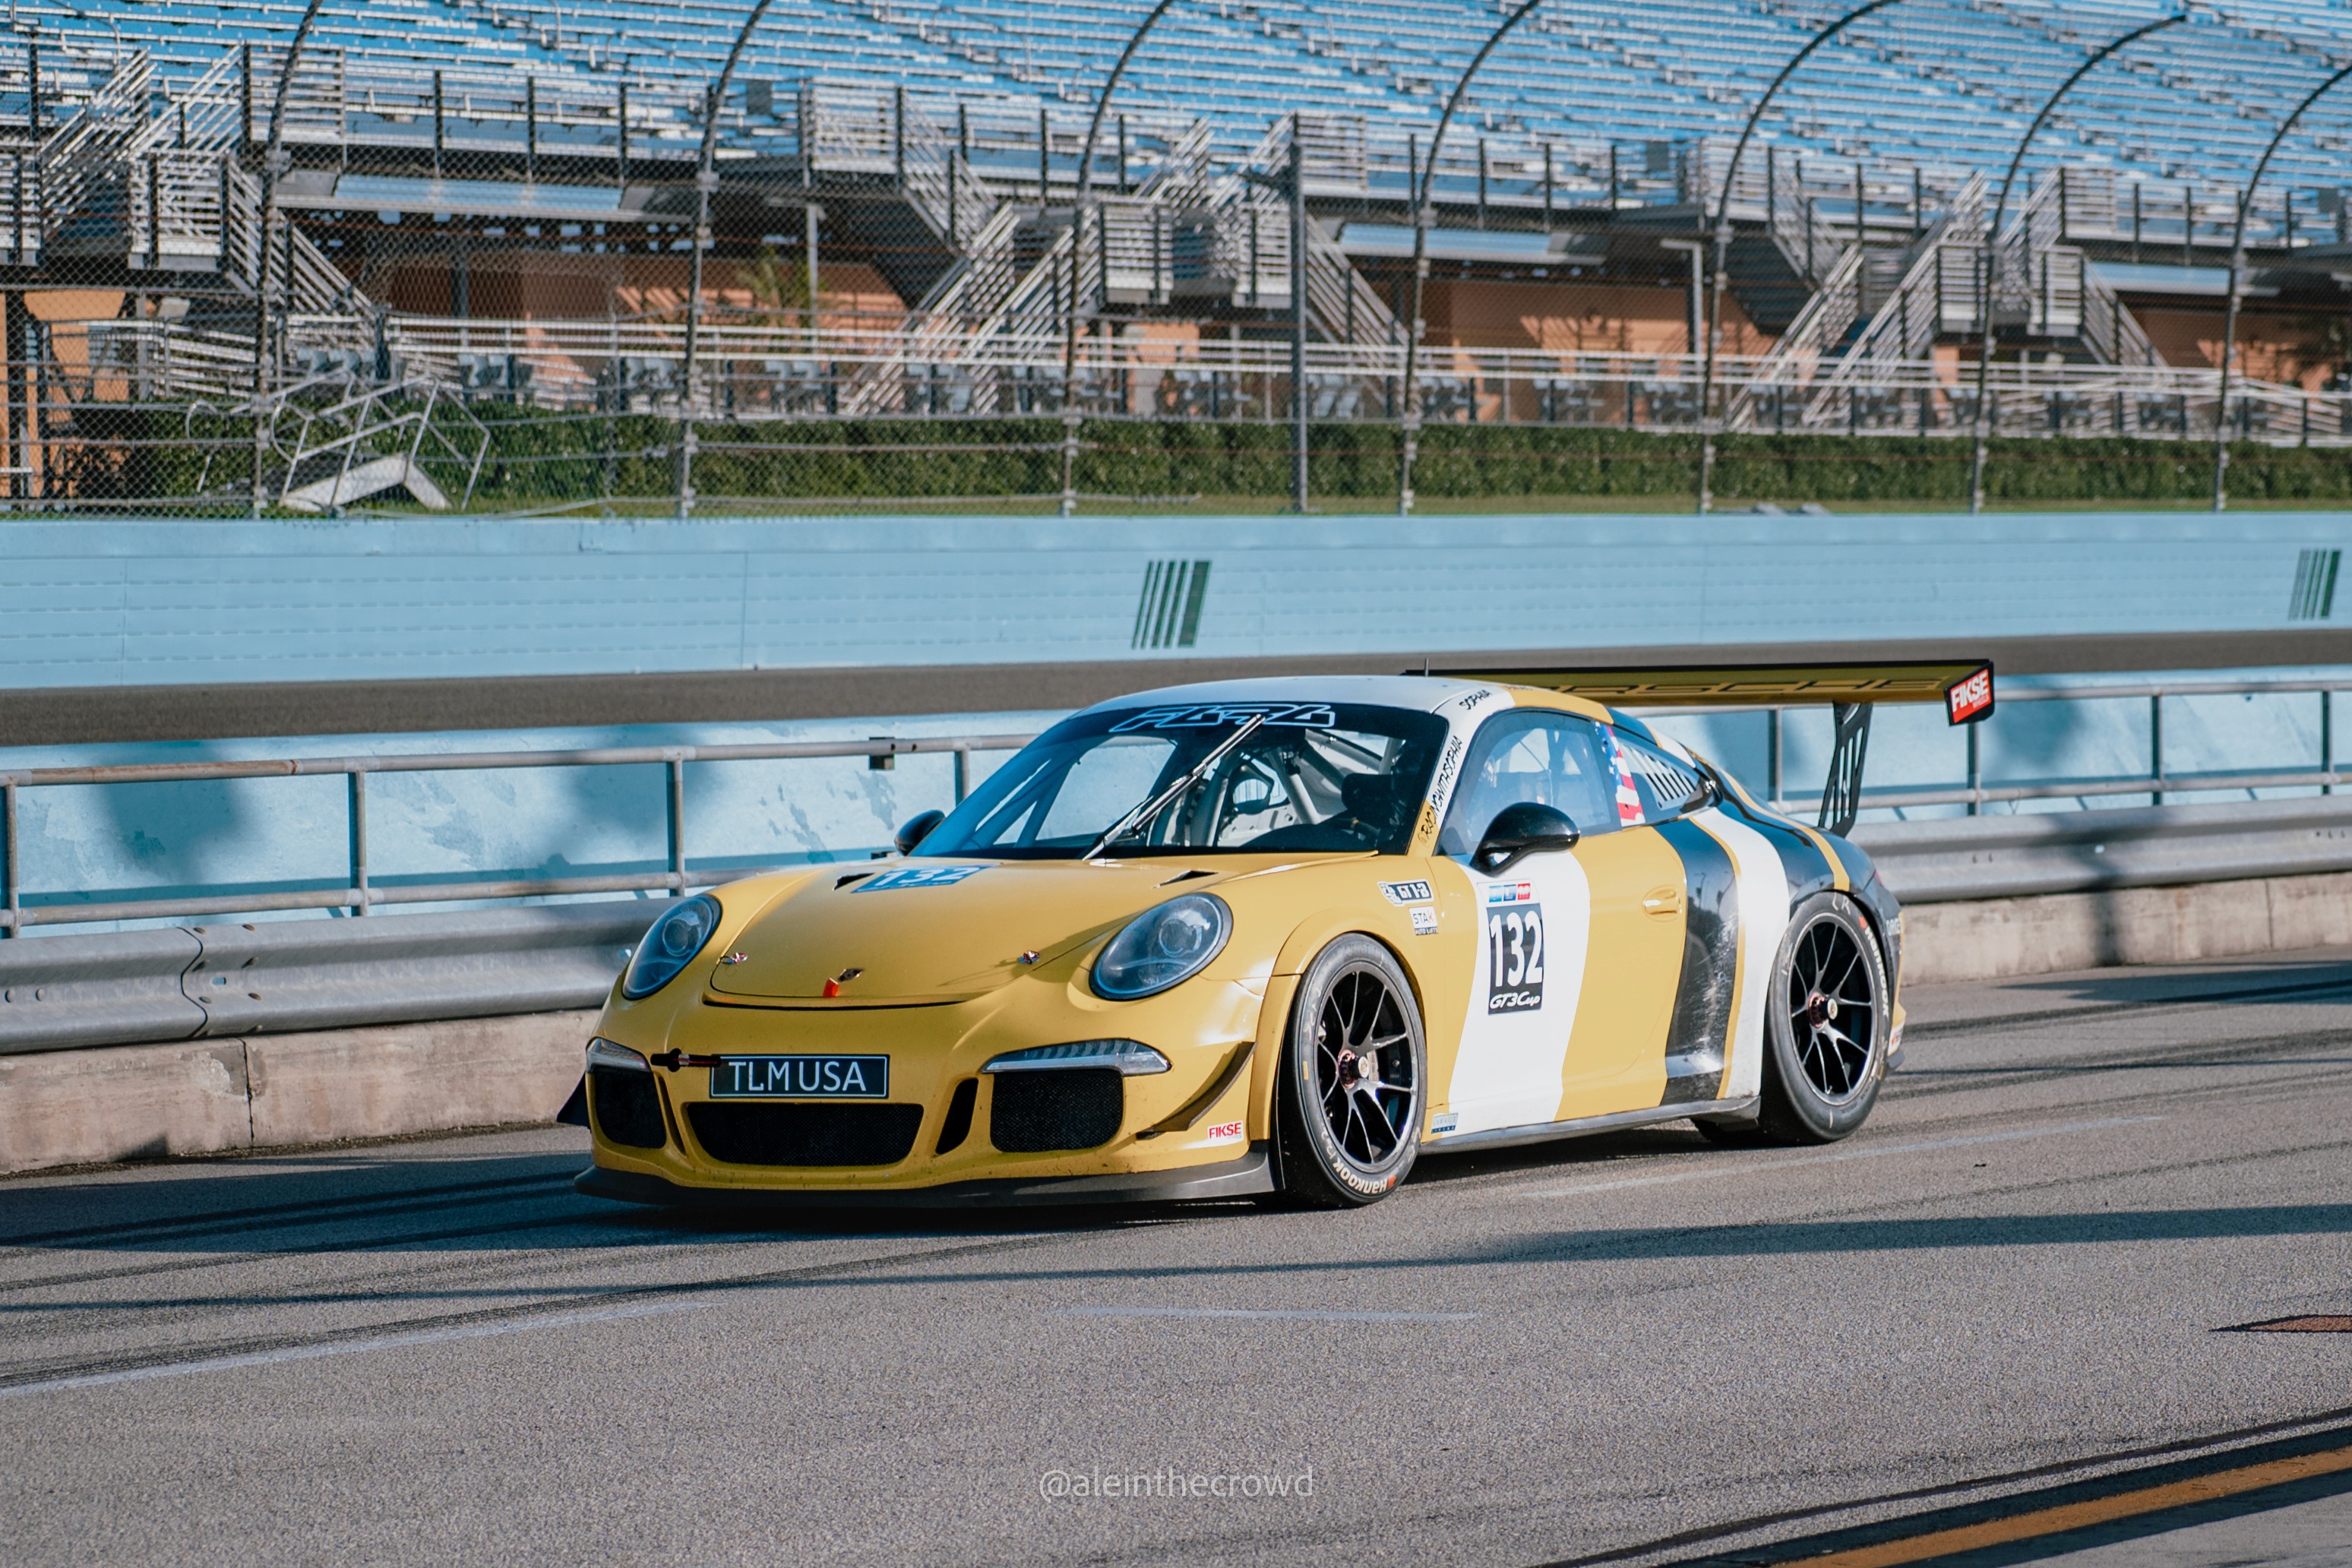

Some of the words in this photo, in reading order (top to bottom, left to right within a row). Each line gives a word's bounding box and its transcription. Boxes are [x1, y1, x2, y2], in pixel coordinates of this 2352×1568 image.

[1459, 689, 1493, 710] SOPHIA
[1951, 672, 1988, 713] FIKSE
[874, 867, 981, 887] 132
[1489, 910, 1543, 987] 132
[728, 1061, 789, 1092] TLM
[798, 1061, 867, 1092] USA
[1209, 1122, 1241, 1140] FIKSE
